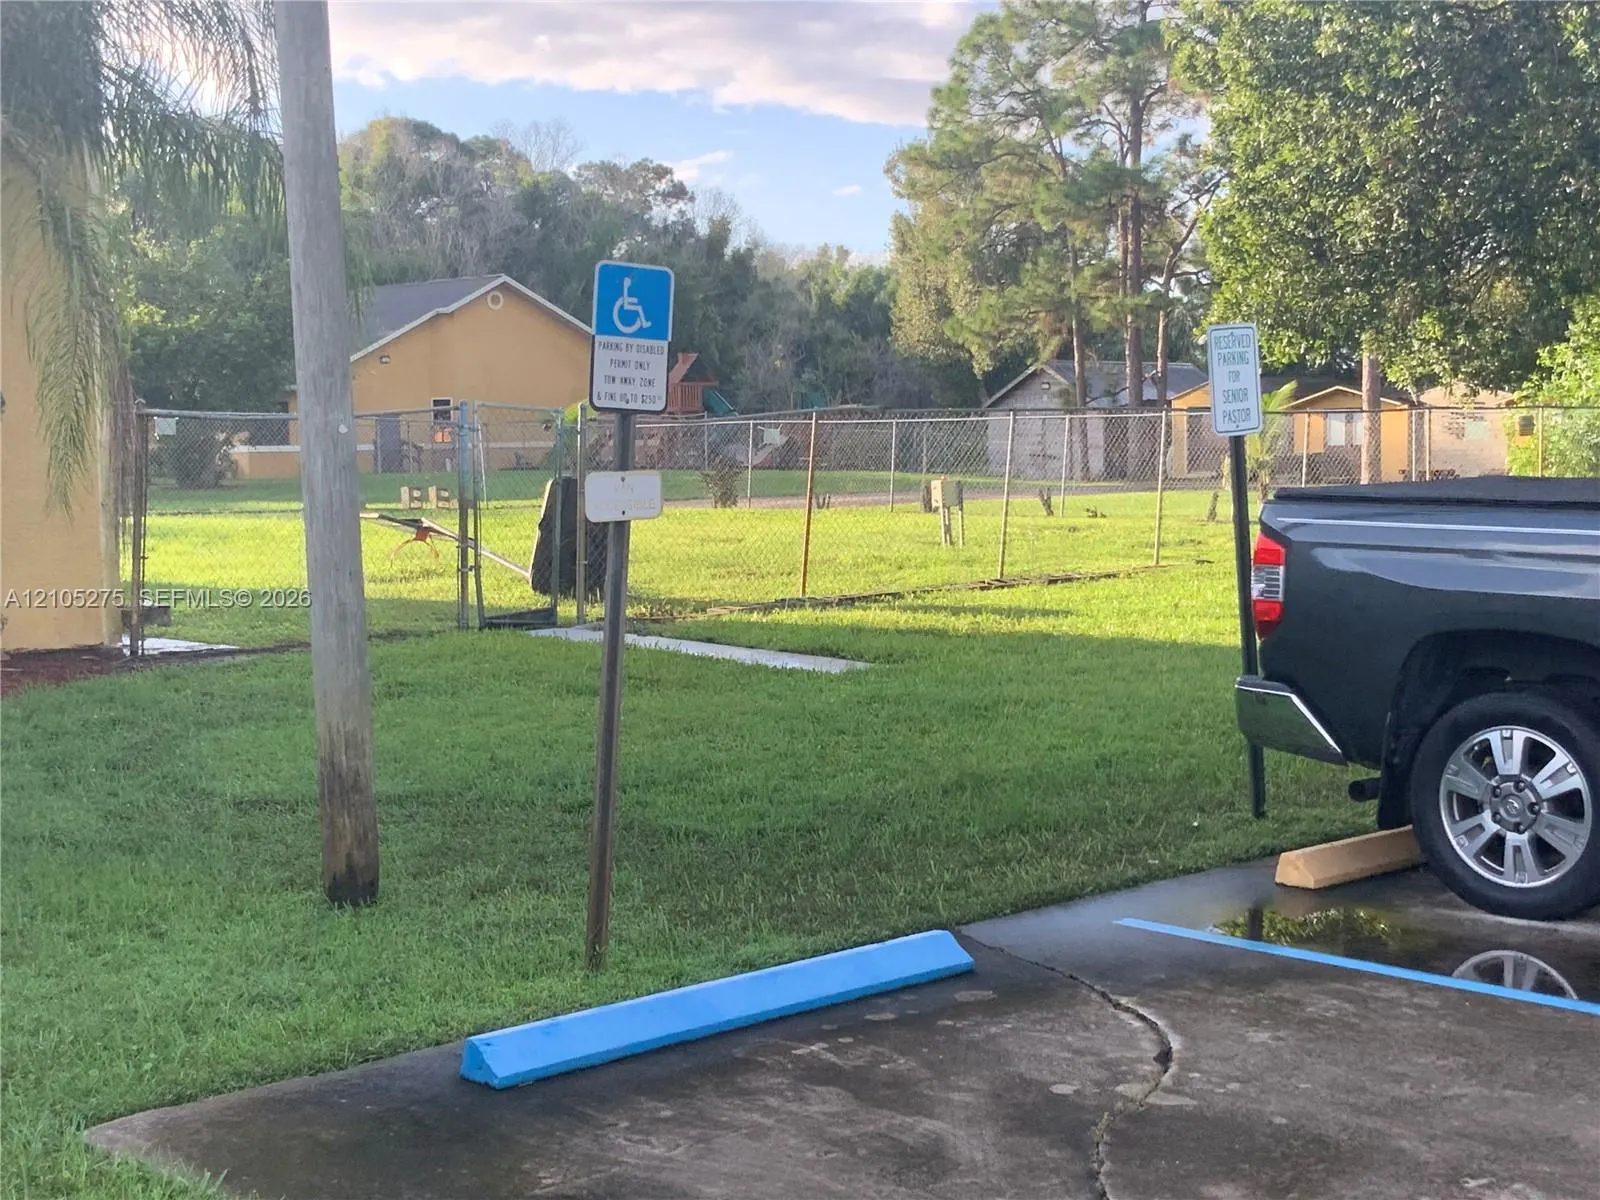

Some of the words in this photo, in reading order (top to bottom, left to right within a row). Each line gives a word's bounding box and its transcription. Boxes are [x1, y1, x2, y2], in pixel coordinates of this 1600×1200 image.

[599, 341, 624, 353] PARKING
[626, 343, 633, 353] BY
[636, 344, 665, 356] DISABLED
[1213, 334, 1251, 349] RESERVED
[610, 358, 631, 369] PERMIT
[634, 360, 651, 371] ONLY
[1217, 351, 1249, 366] PARKING
[604, 375, 616, 385] TOW
[620, 377, 636, 387] AWAY
[640, 377, 656, 388] ZONE
[1228, 370, 1241, 382] FOR
[597, 391, 602, 401] &
[604, 392, 617, 401] FINE
[630, 393, 638, 403] TO
[1222, 388, 1249, 404] SENIOR
[1222, 408, 1251, 425] PASTOR
